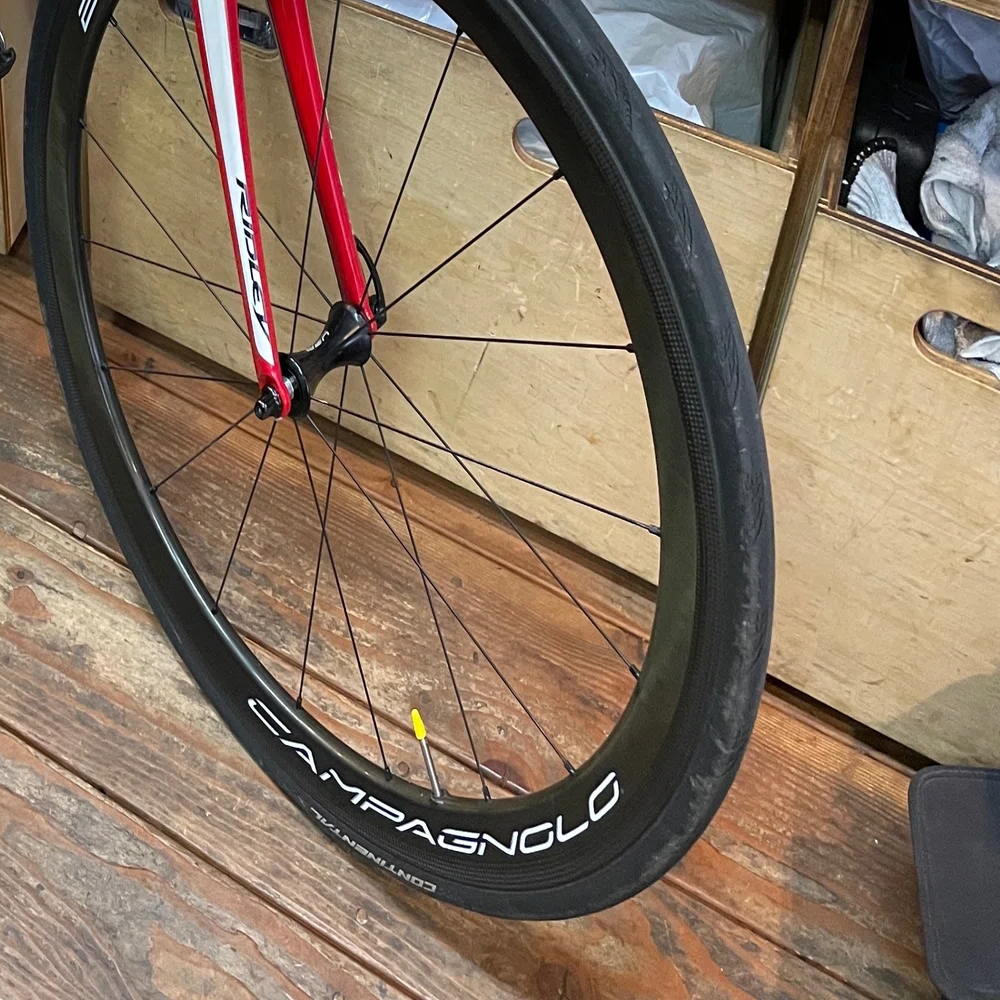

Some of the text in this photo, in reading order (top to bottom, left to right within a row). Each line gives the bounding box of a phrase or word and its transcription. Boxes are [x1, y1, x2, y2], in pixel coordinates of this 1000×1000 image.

[235, 177, 271, 341] RIDLEY
[247, 697, 621, 857] CAMPAGNOLO
[310, 805, 437, 895] CONTINENTAL
